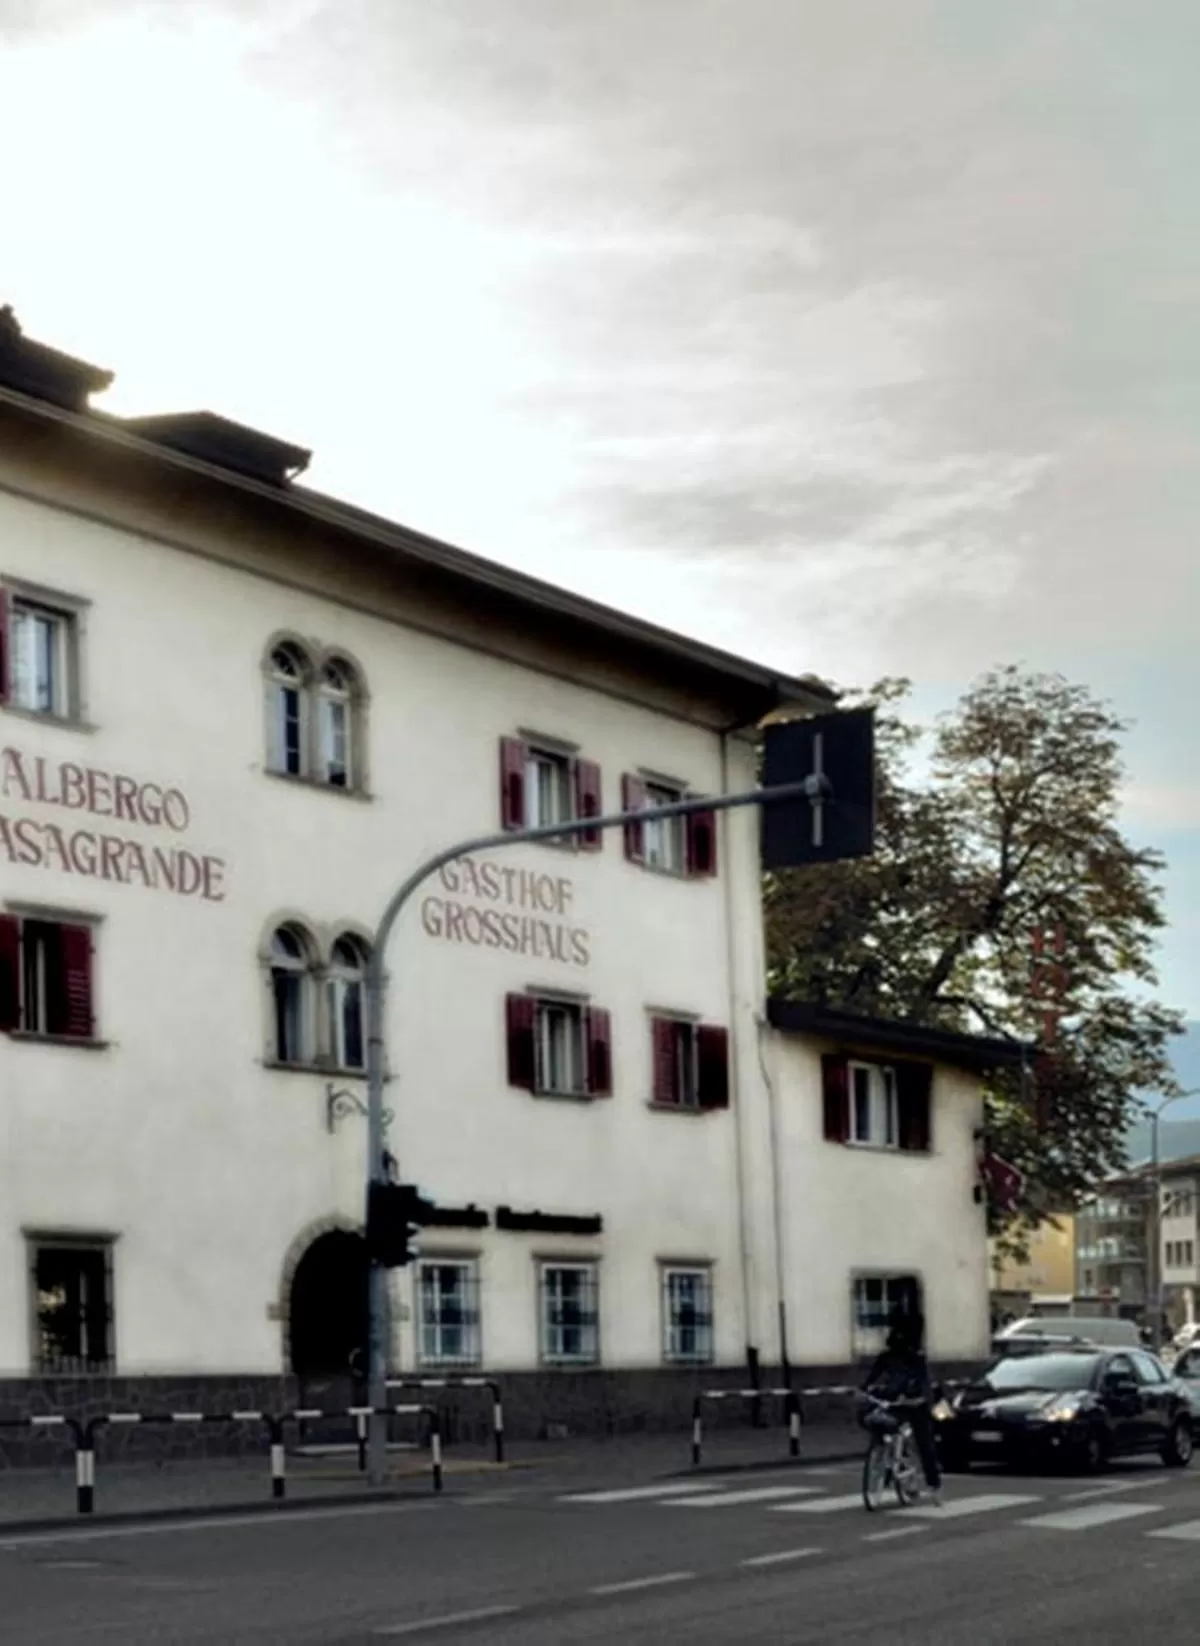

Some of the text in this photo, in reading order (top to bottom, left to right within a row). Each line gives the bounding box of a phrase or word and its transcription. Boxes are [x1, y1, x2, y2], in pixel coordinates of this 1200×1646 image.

[1, 746, 189, 832] ALBERGO
[439, 856, 573, 914] GASTHOF
[420, 895, 590, 967] GROSSHAUS
